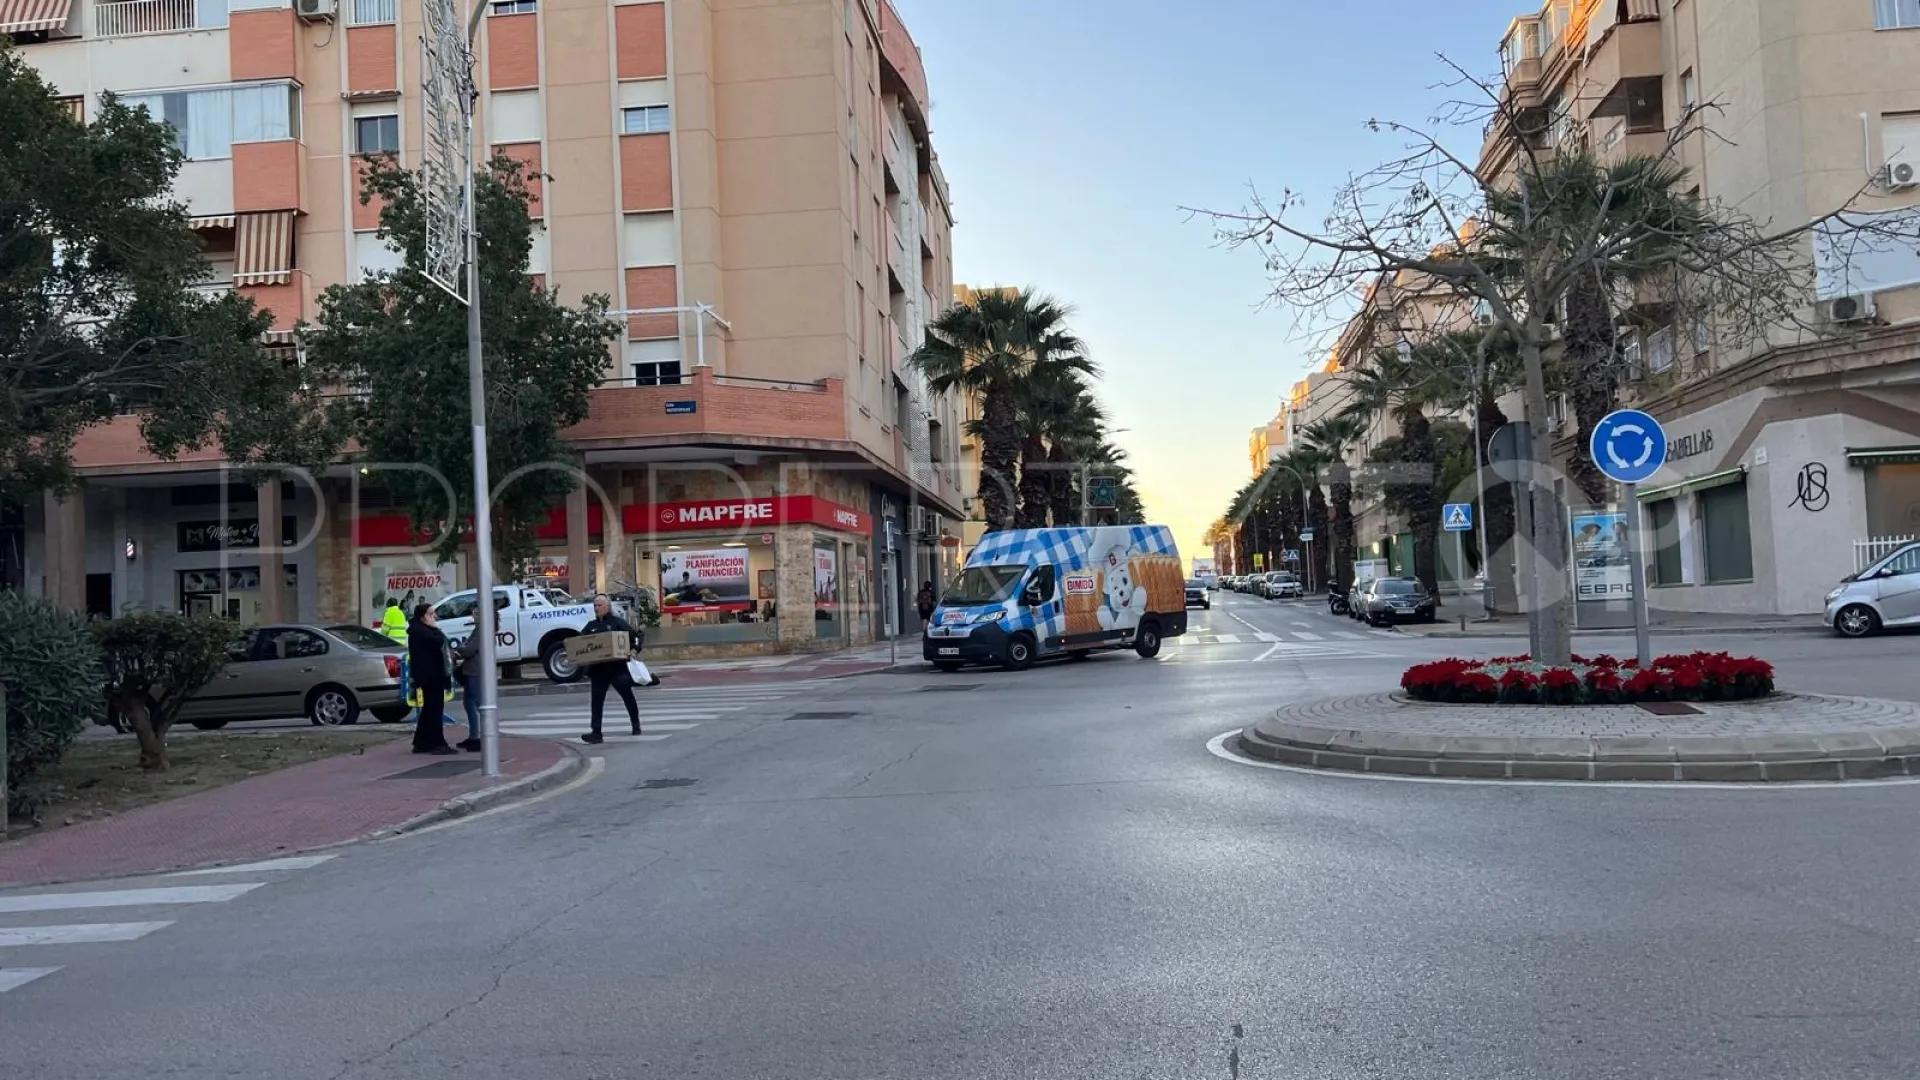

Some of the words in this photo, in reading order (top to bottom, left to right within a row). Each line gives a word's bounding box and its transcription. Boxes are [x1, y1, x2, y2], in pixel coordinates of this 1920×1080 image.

[679, 503, 773, 522] MAPFRE
[837, 510, 858, 527] MAPFRE
[698, 568, 745, 578] FINANCIERA
[387, 575, 441, 590] NEGOCIO?
[1067, 579, 1094, 589] BIMBO
[530, 607, 588, 620] ASISTENCIA
